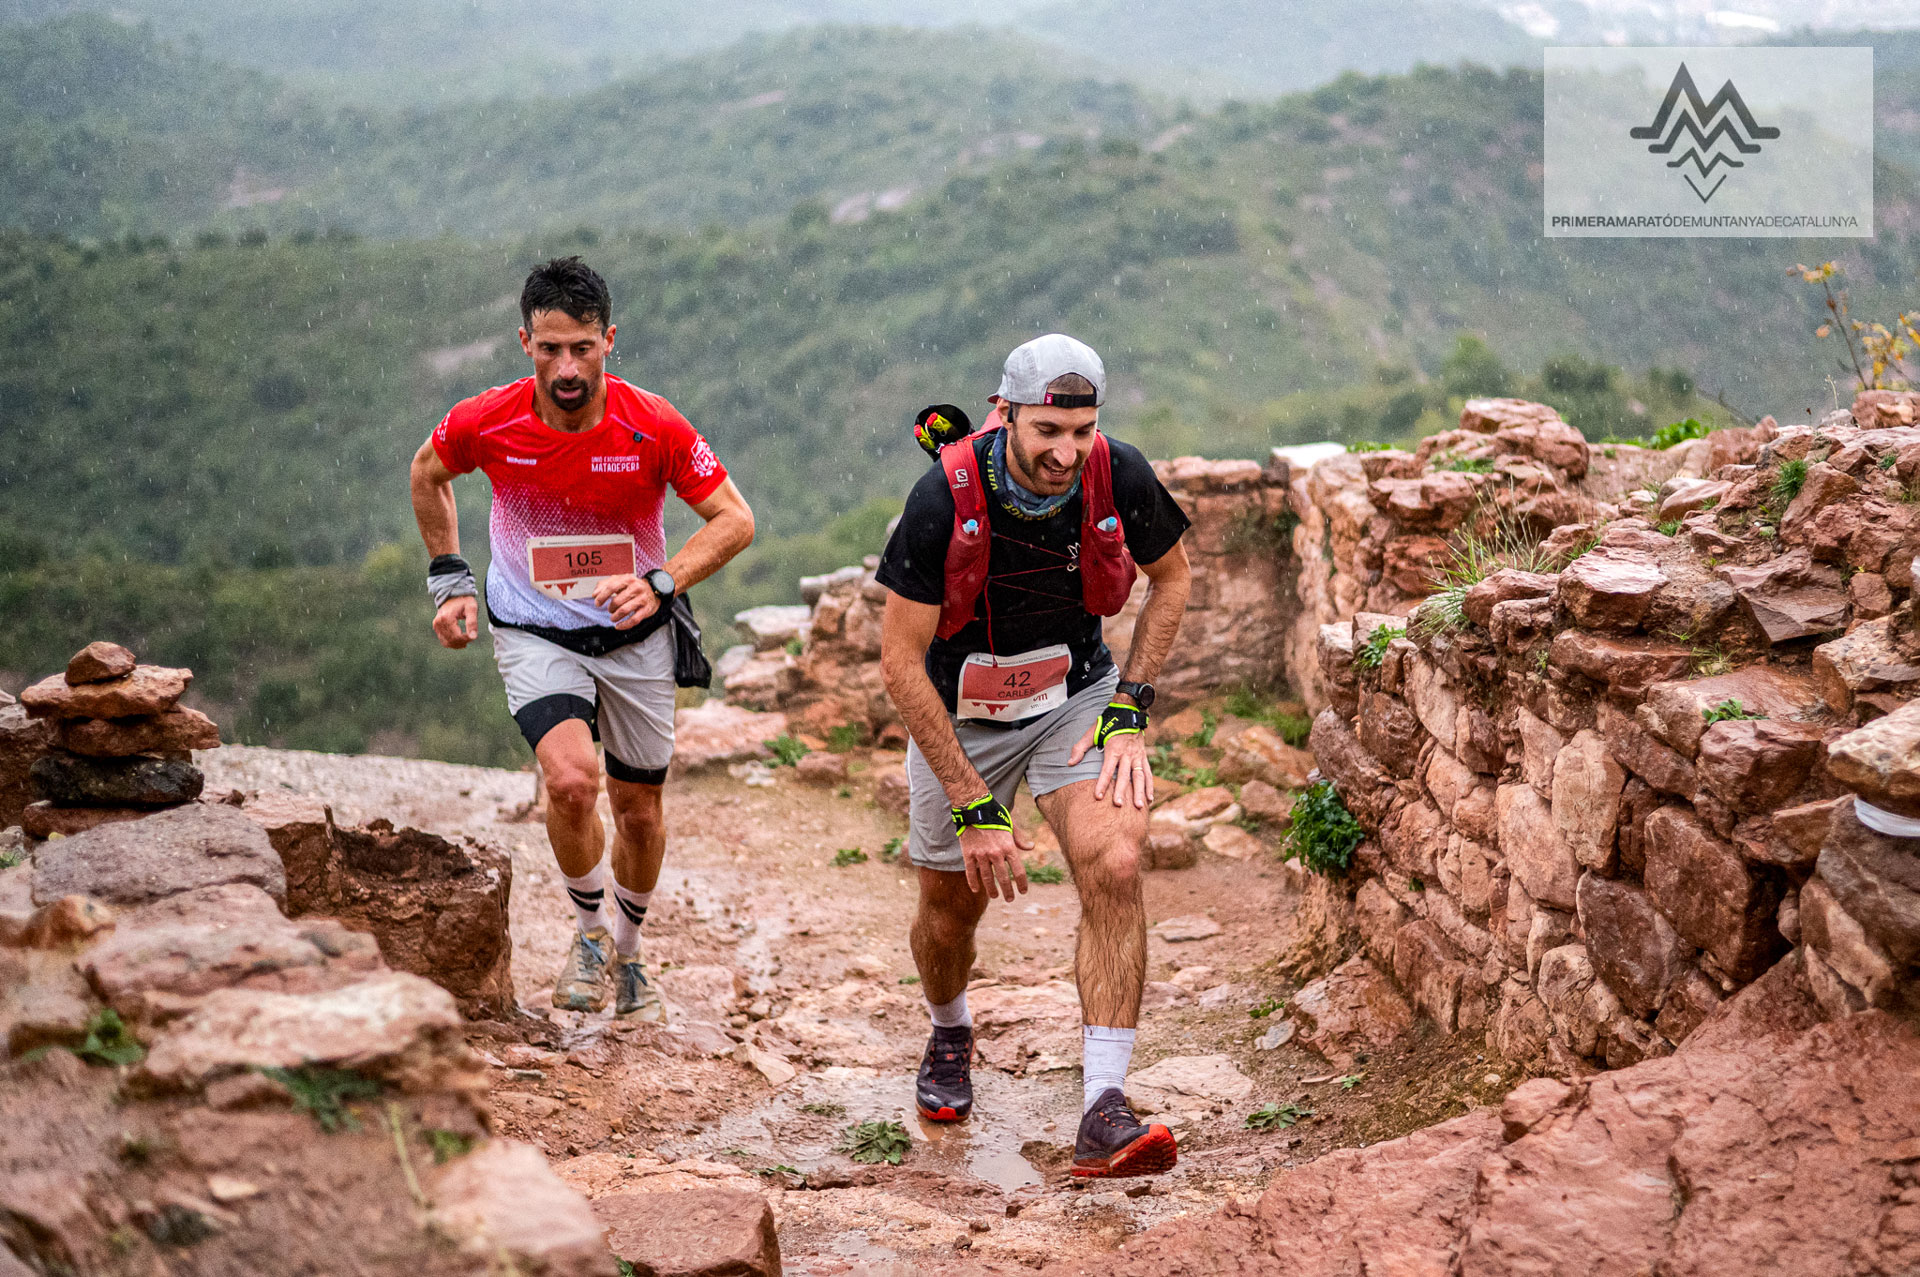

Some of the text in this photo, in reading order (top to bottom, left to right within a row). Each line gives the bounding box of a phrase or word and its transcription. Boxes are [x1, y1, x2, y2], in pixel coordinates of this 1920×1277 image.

[591, 462, 640, 472] MATADEPERA
[564, 551, 603, 568] 105
[571, 568, 598, 576] SANTI
[1003, 671, 1031, 688] 42
[997, 688, 1036, 698] CARLES
[1100, 716, 1119, 735] LEKI
